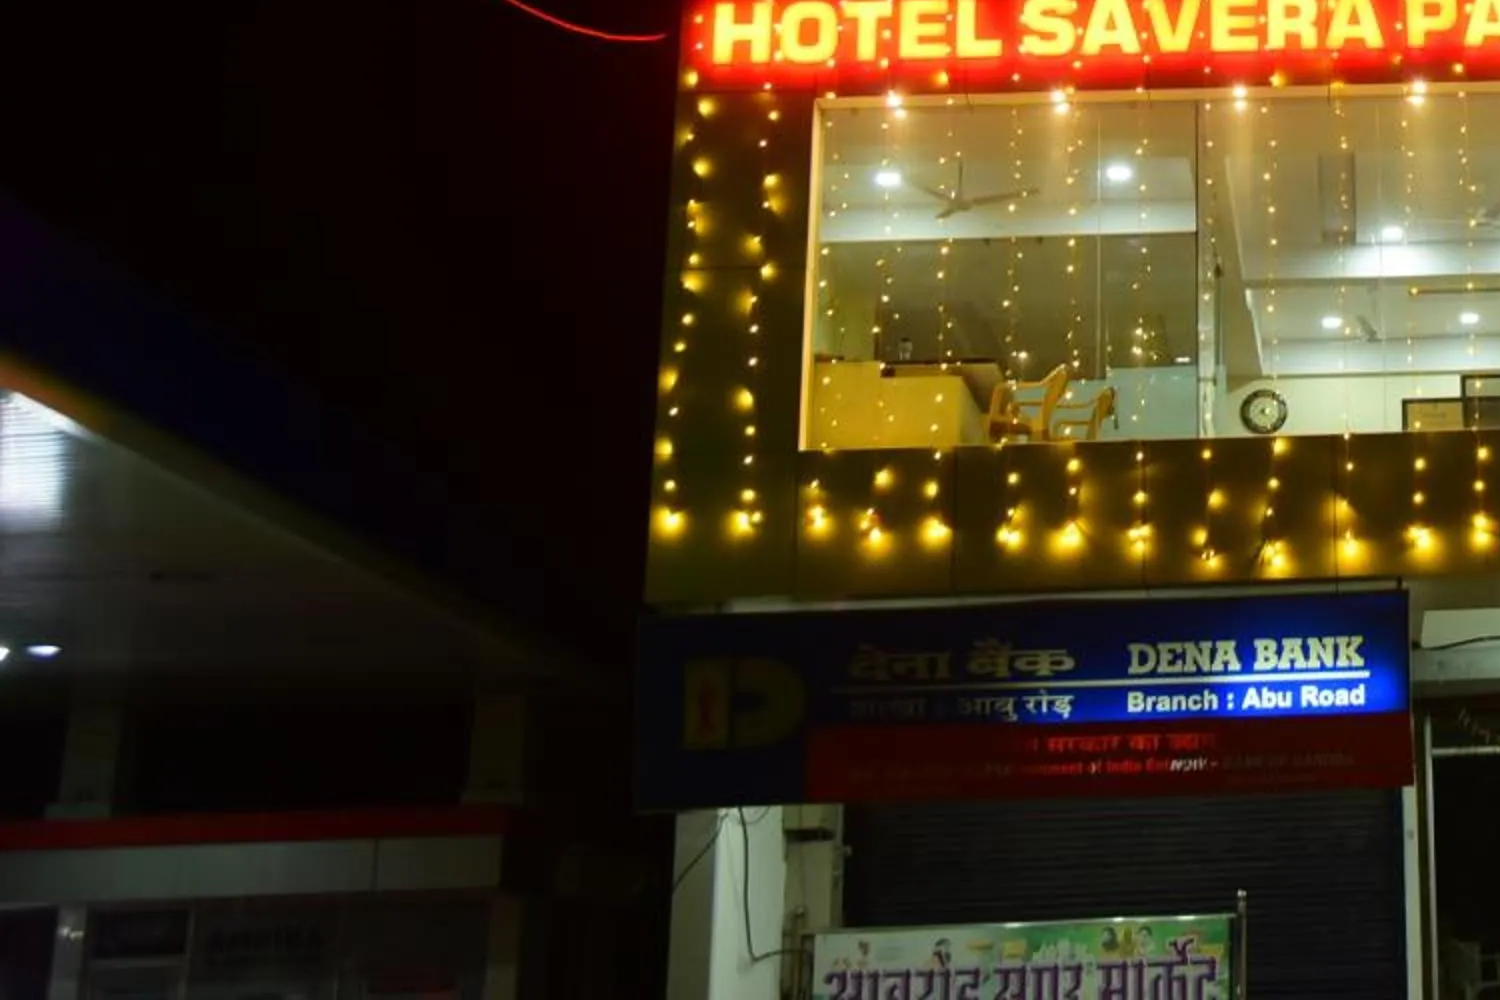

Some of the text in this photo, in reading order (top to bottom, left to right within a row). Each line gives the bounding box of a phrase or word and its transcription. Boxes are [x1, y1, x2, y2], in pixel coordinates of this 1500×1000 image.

[1126, 635, 1366, 676] DENA BANK
[1126, 688, 1219, 714] Branch
[1241, 685, 1292, 711] Abu
[1301, 683, 1366, 708] Road
